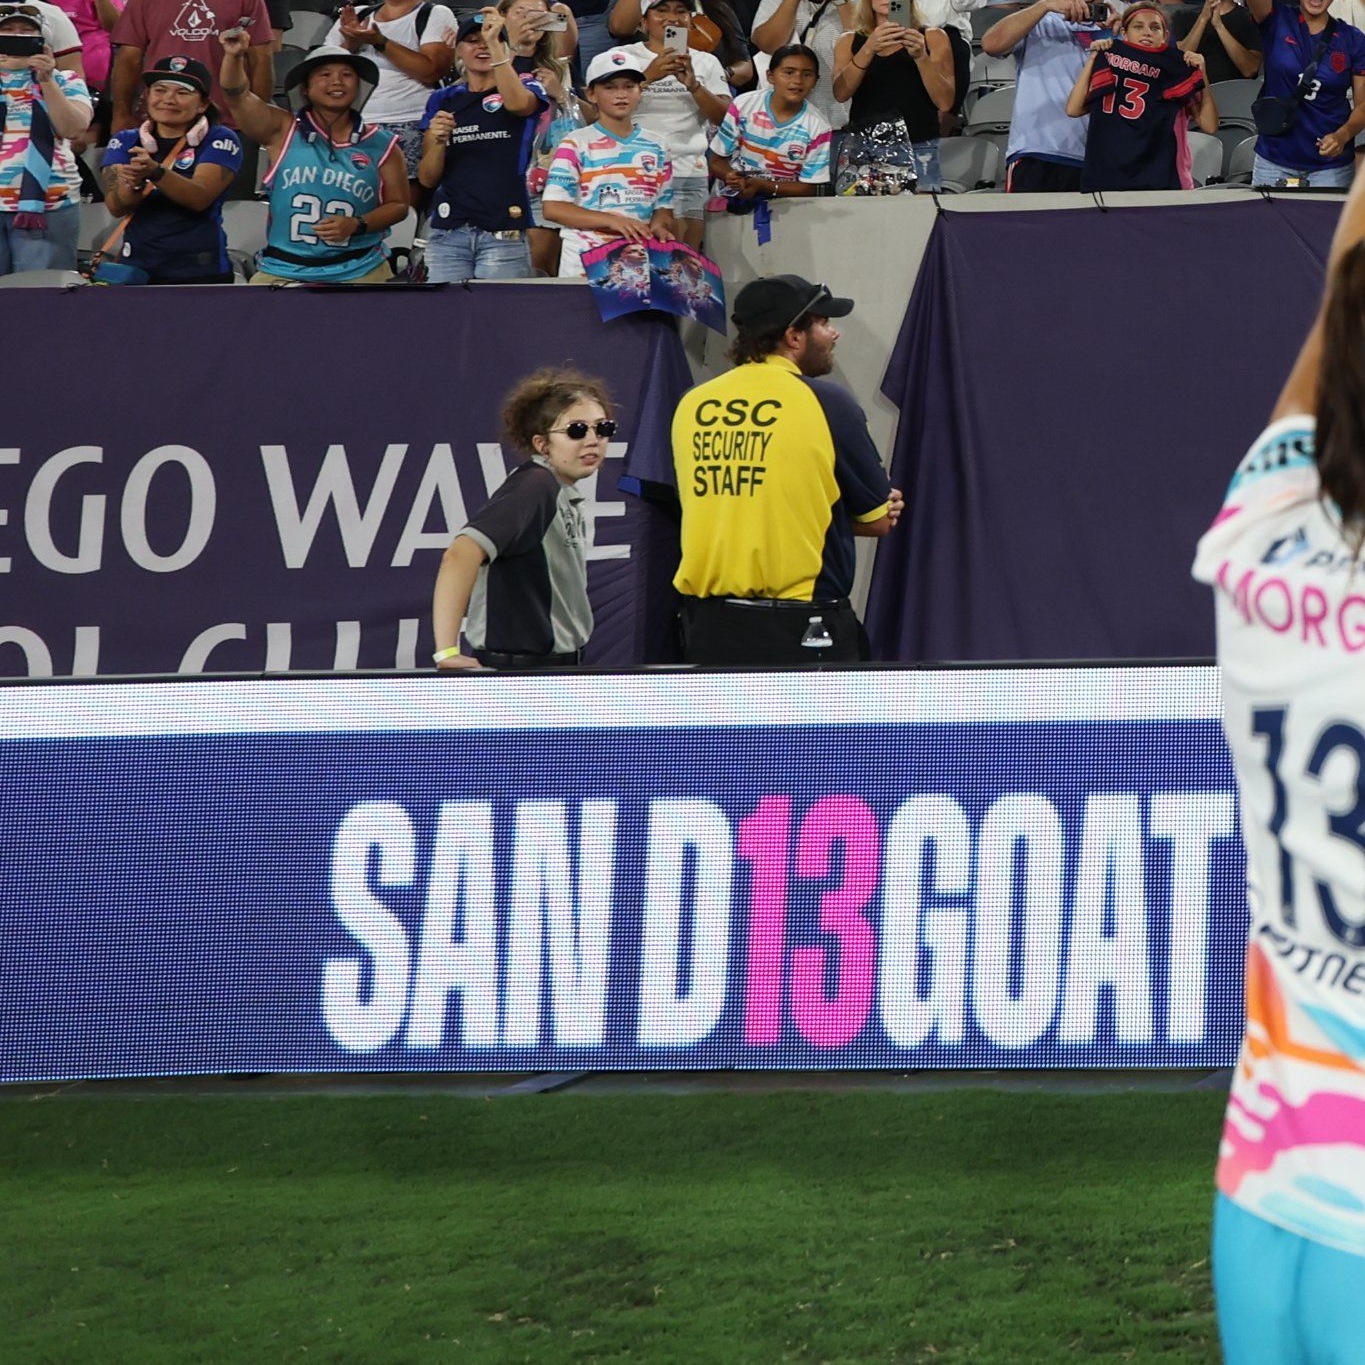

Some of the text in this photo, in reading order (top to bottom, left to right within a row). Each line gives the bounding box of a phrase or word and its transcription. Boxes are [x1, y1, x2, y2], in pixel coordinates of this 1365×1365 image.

[169, 27, 219, 37] VOLCOM
[1104, 51, 1161, 79] MORGAN
[1103, 76, 1149, 120] 13
[453, 124, 480, 135] KAISER
[210, 137, 240, 155] ally
[282, 166, 374, 202] SAN DIEGO
[694, 399, 782, 427] CSC
[692, 430, 773, 463] SECURITY
[692, 467, 766, 498] STAFF
[0, 445, 216, 575] GO
[320, 790, 1238, 1052] SAN D13GOAT
